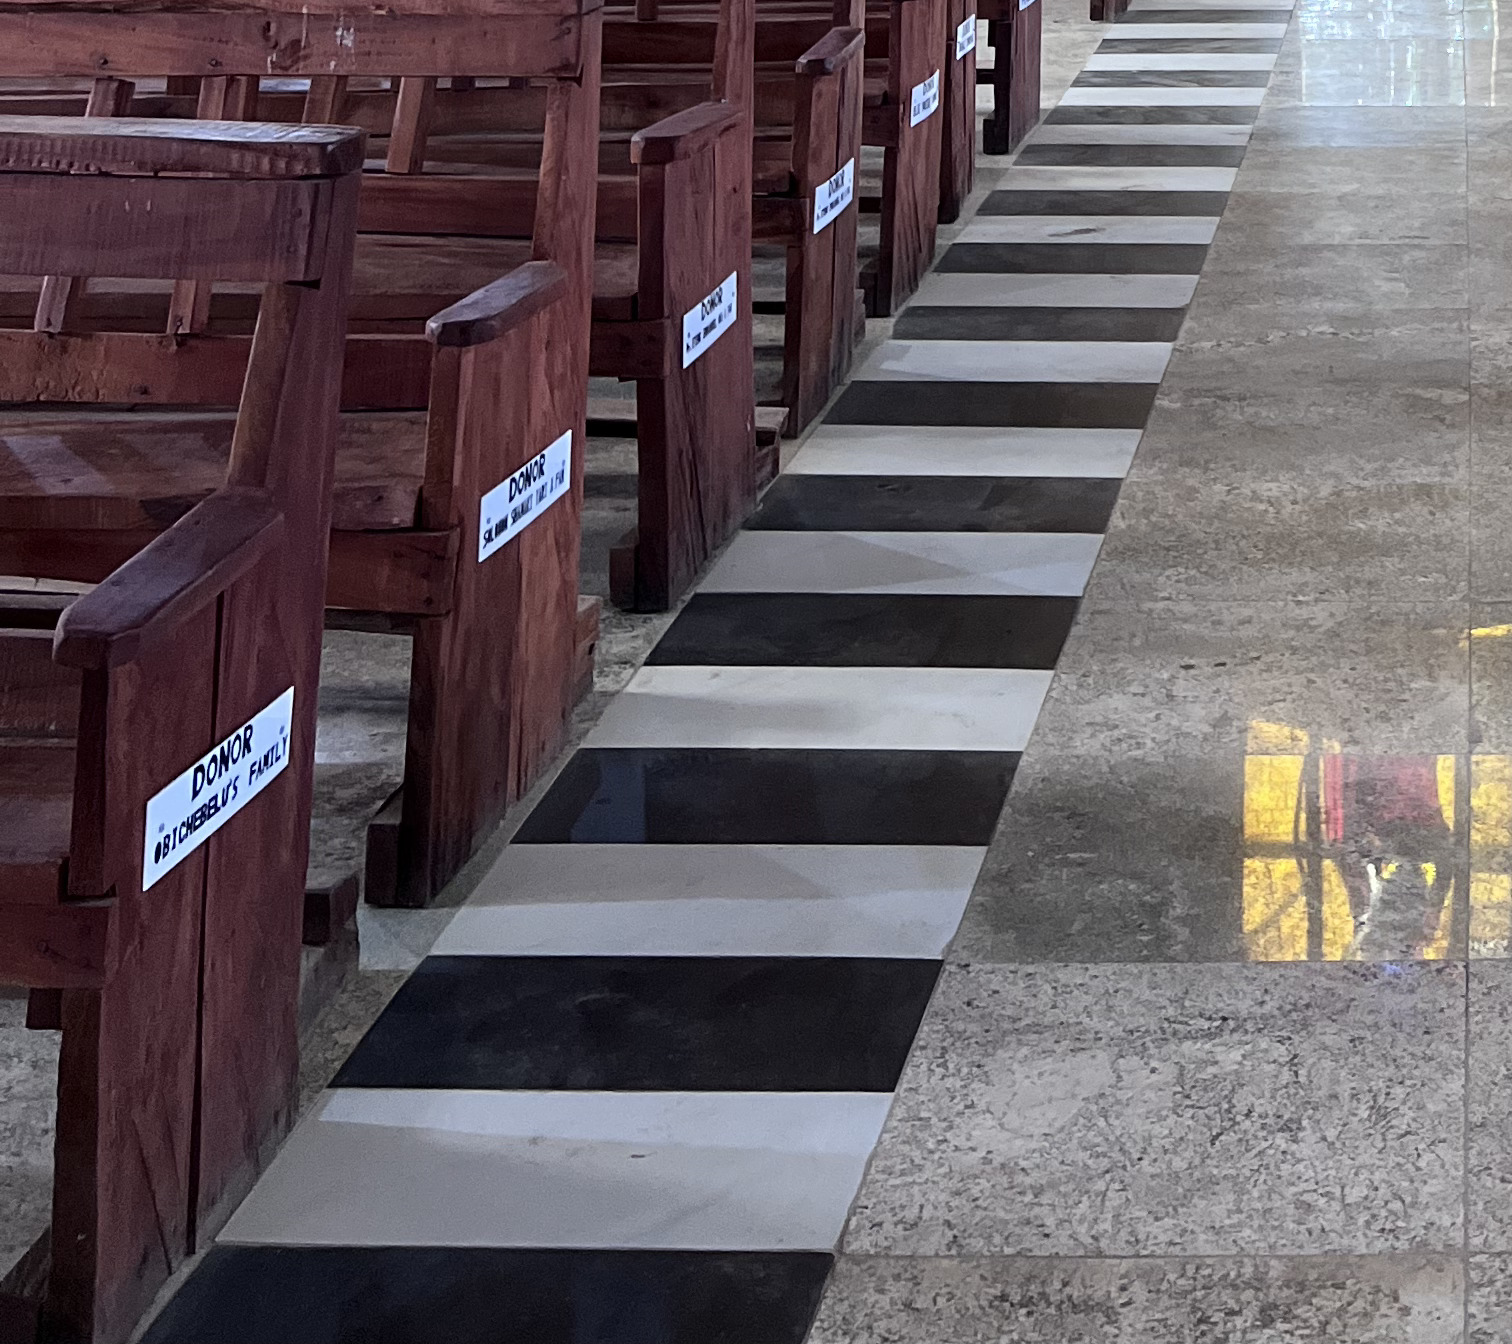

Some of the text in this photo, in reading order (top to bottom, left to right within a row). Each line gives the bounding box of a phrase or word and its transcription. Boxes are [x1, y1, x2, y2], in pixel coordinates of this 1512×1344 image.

[508, 453, 546, 503] DONOR
[191, 724, 253, 802] DONOR
[248, 734, 288, 786] FAMILY
